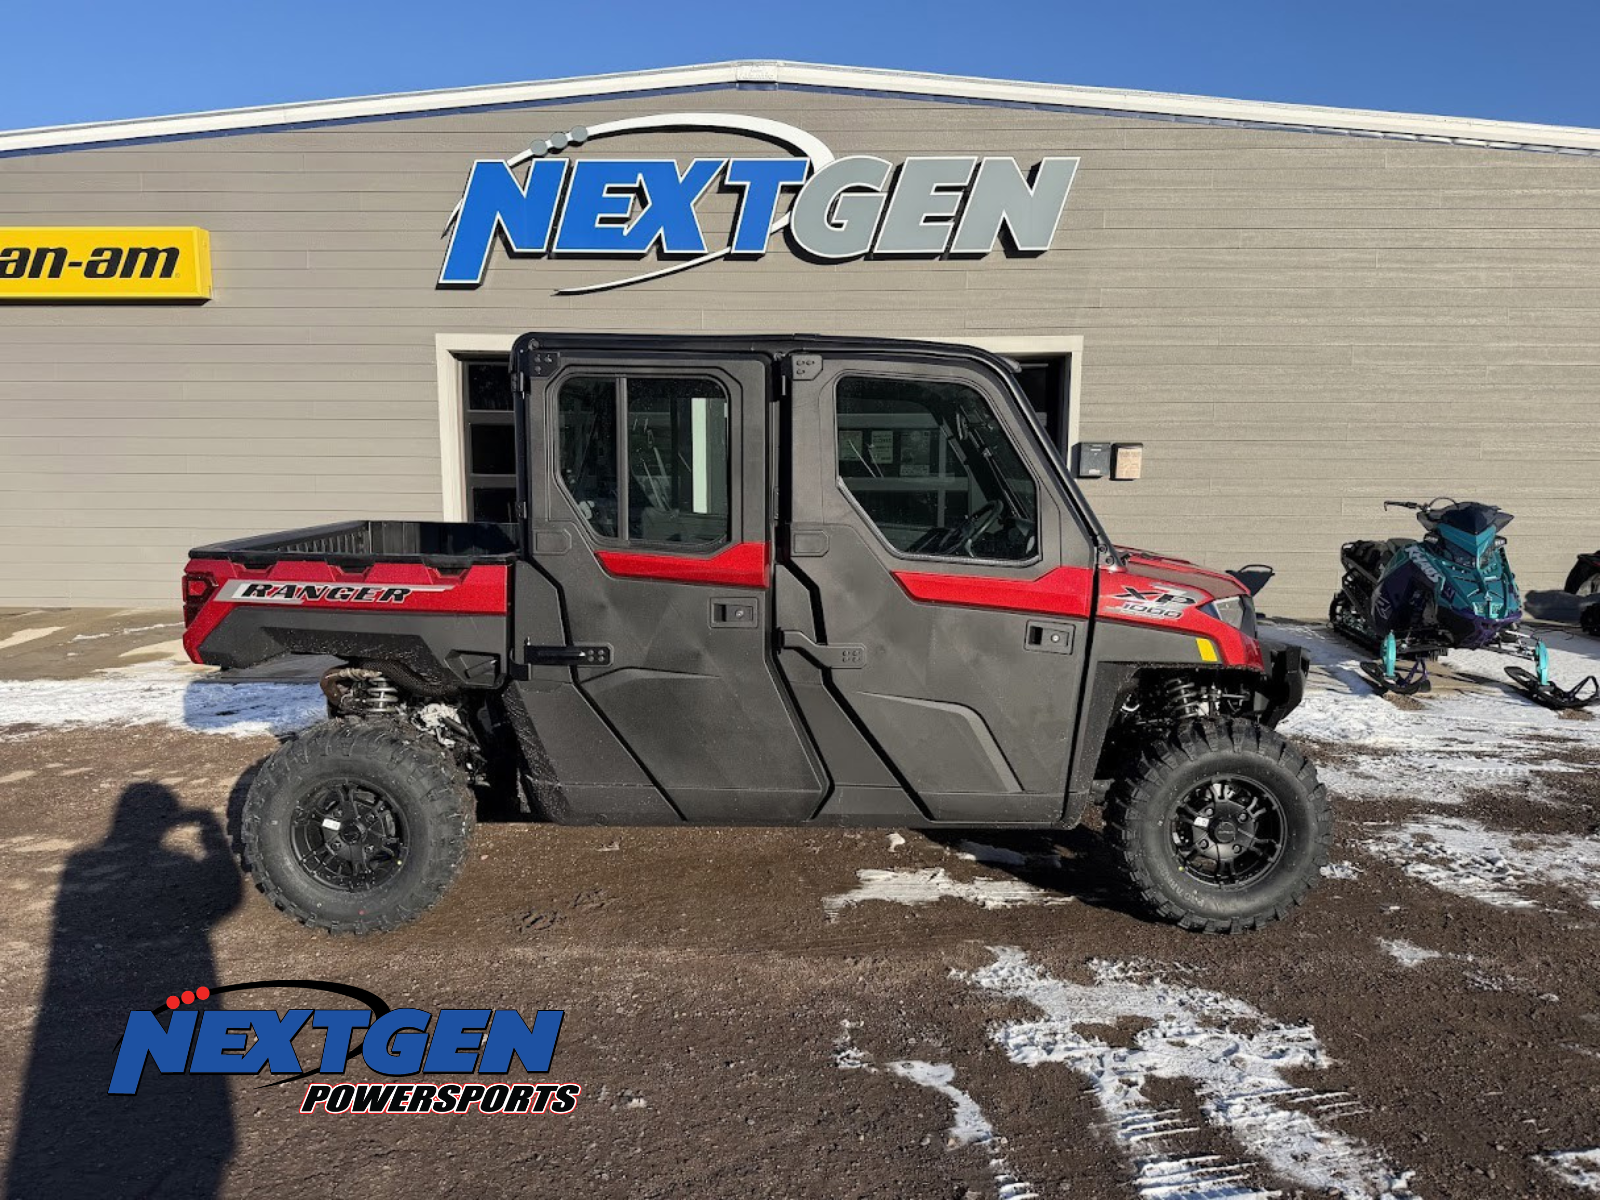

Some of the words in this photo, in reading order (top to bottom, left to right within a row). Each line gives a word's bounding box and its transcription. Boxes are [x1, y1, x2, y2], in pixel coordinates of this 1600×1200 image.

[437, 154, 1081, 285] NEXTGEN
[1404, 545, 1440, 583] KHAOS
[240, 582, 412, 603] RANGER
[1113, 586, 1197, 605] XP
[1120, 602, 1183, 618] 1000
